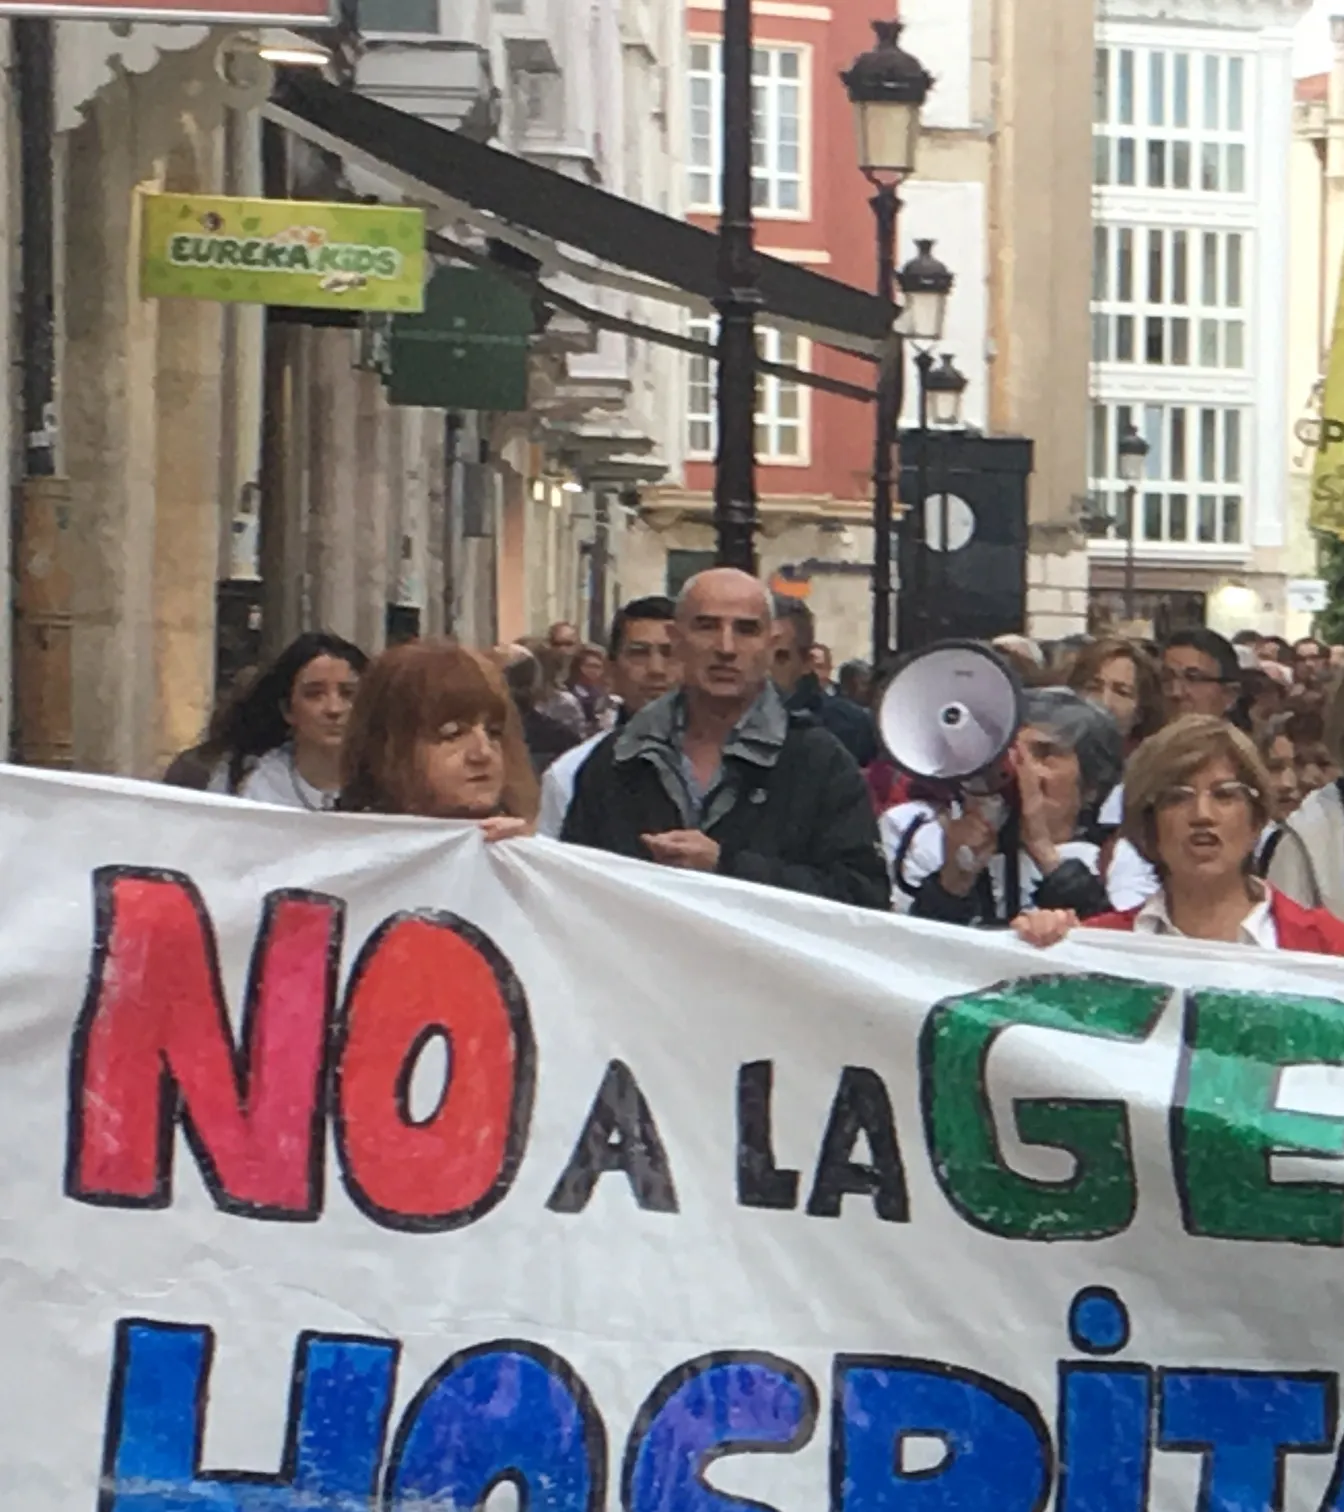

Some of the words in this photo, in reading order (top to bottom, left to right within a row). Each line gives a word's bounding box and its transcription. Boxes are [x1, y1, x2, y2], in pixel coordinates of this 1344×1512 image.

[64, 863, 539, 1233] NO
[545, 1058, 680, 1213] A
[735, 1058, 911, 1224] LA
